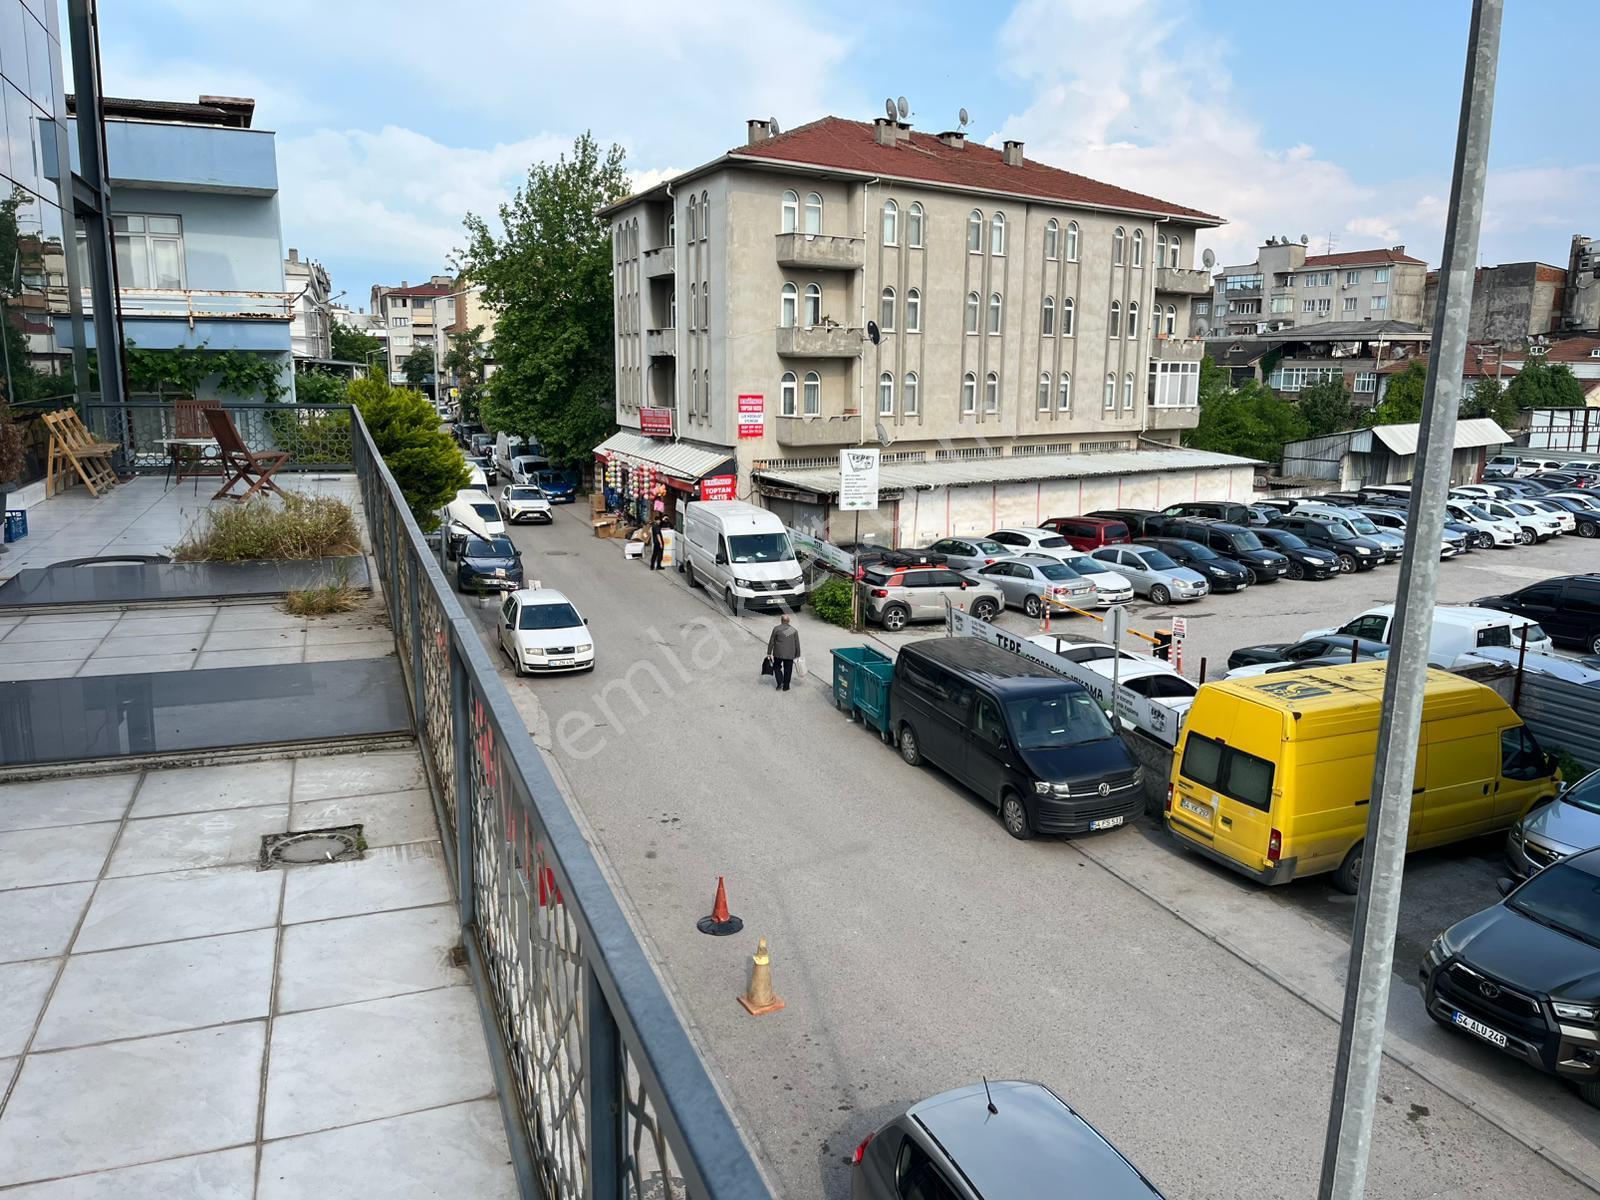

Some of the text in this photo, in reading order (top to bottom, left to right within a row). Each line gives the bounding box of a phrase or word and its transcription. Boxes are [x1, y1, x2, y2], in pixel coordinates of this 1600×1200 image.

[705, 487, 731, 495] TOPTAN
[1457, 1014, 1505, 1045] 54 ALU 248
